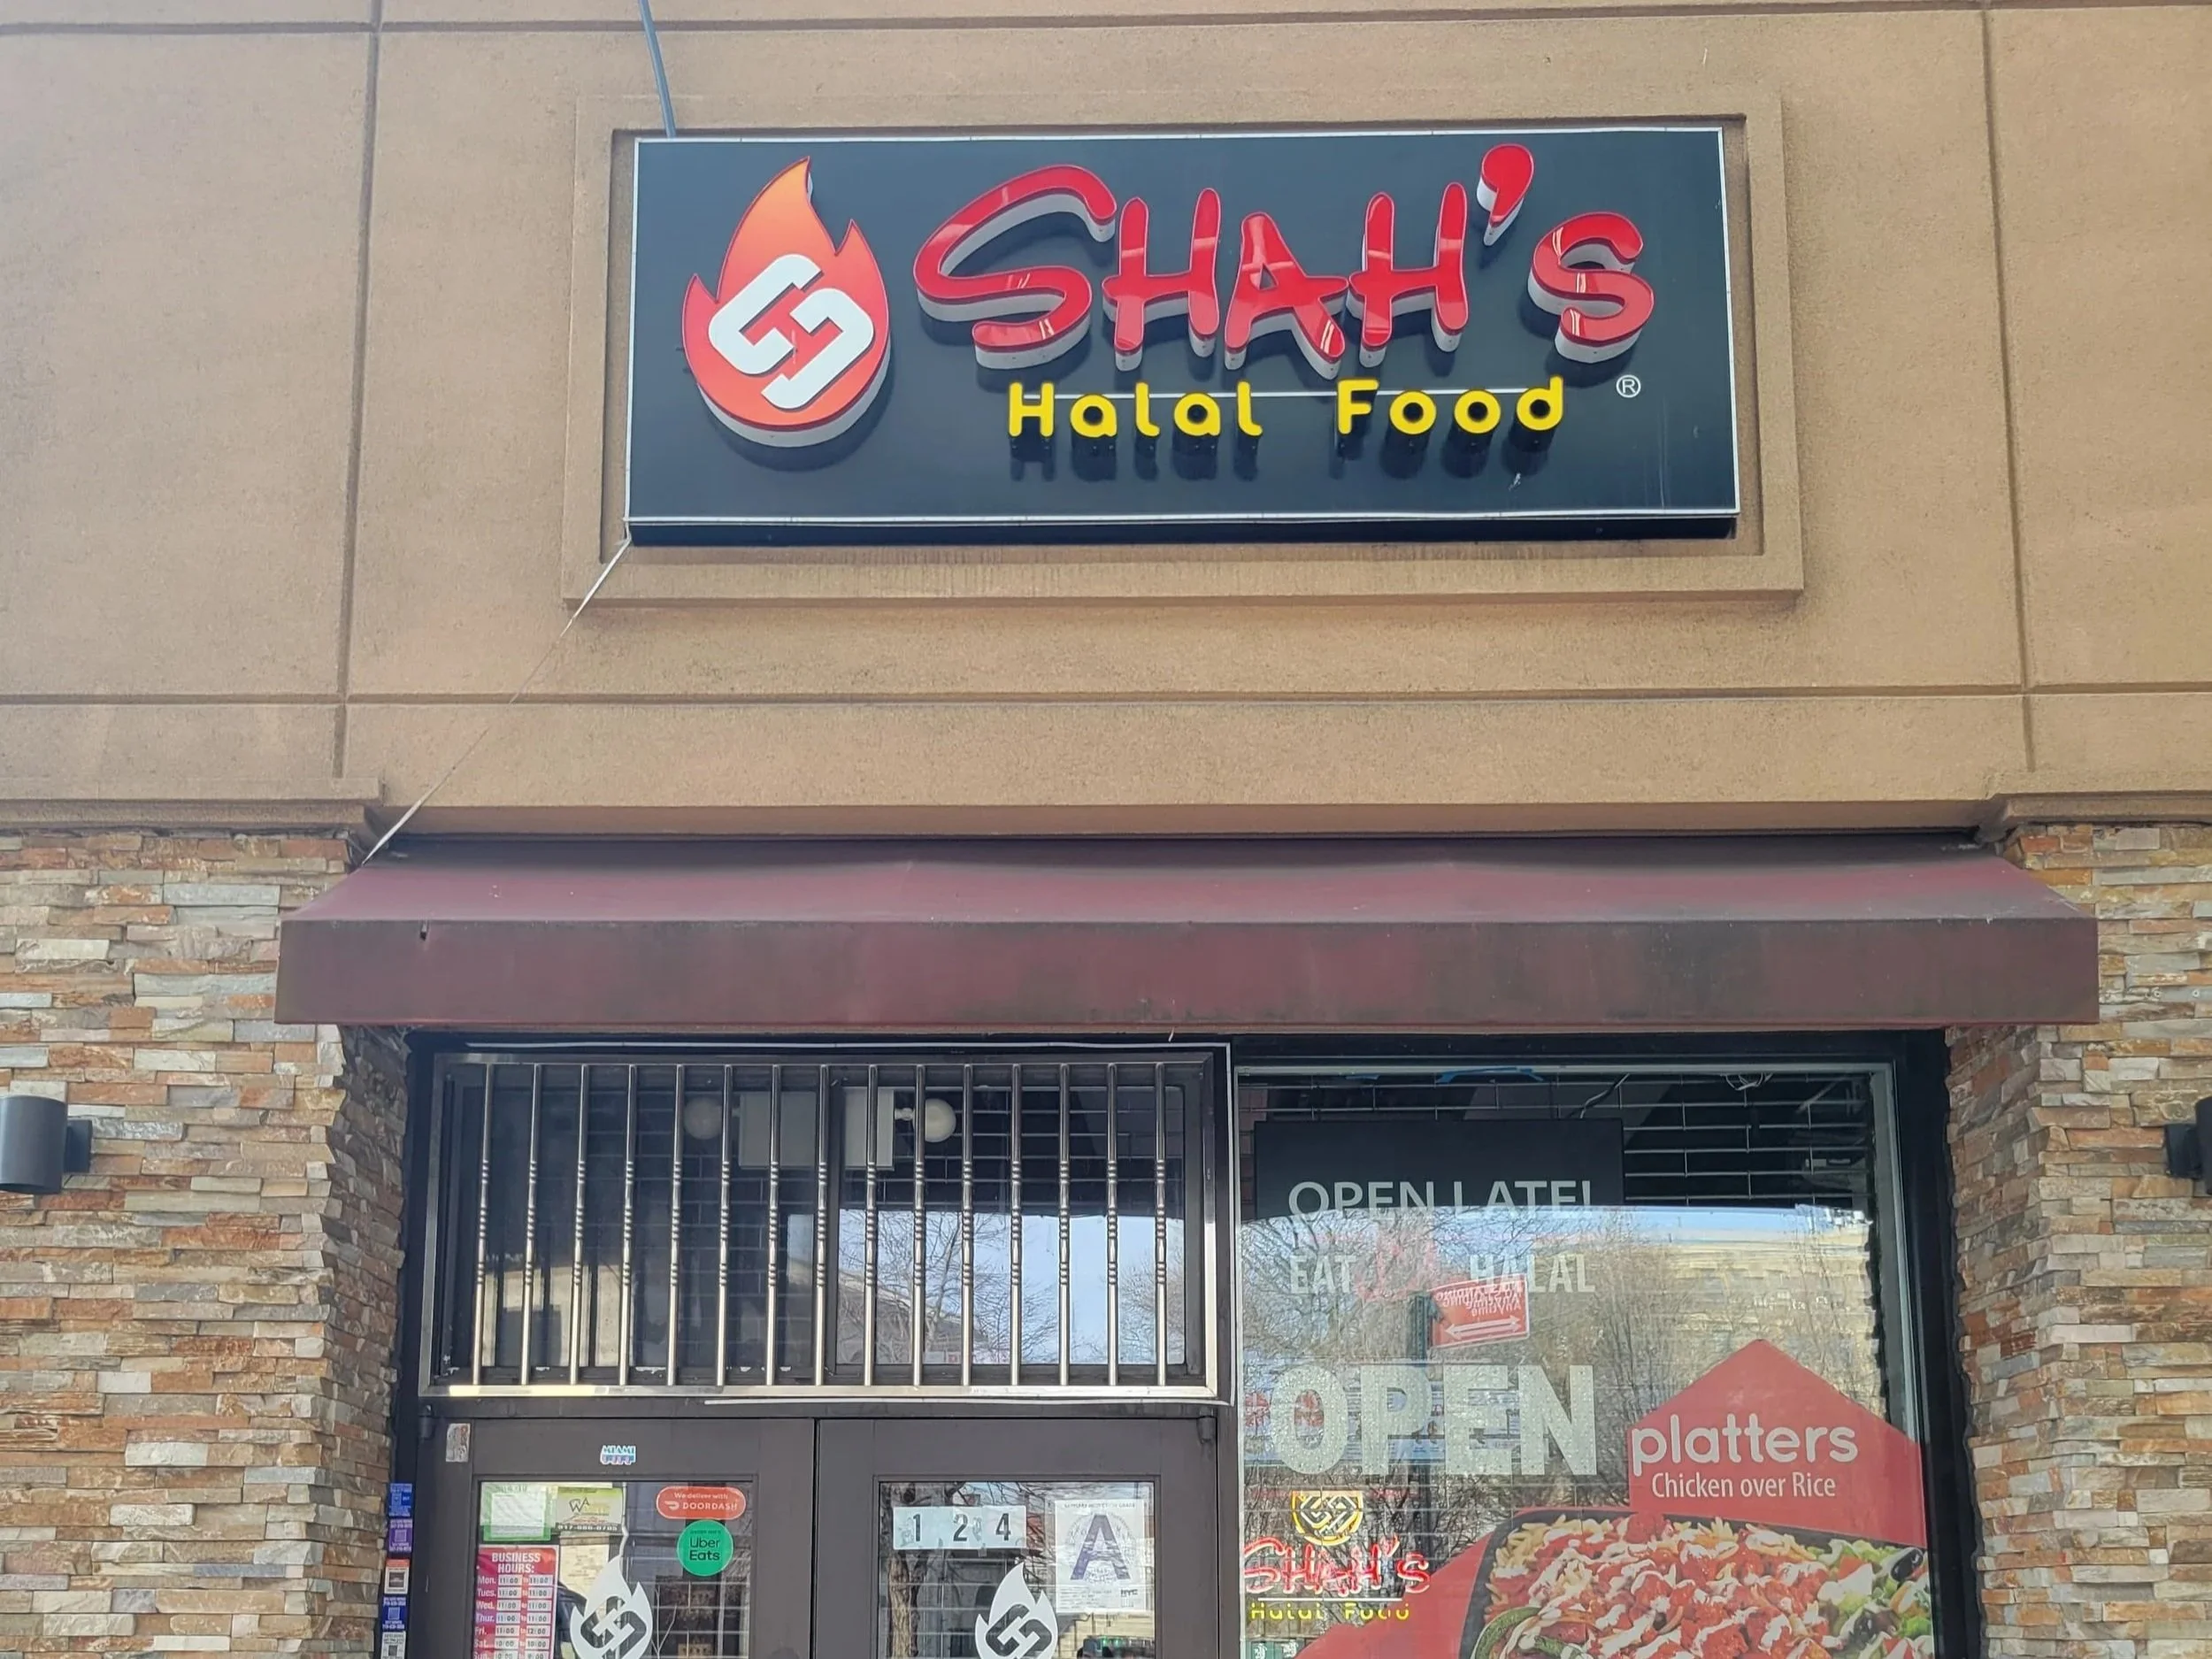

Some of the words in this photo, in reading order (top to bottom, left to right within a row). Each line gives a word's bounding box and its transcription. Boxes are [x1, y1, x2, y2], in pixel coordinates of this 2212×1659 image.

[1007, 381, 1263, 439] Halal
[1334, 378, 1566, 437] Food
[1288, 1180, 1435, 1220] OPEN
[1453, 1179, 1592, 1220] LATE!
[1289, 1255, 1356, 1294] EAT
[1469, 1253, 1596, 1294] HALAL
[1270, 1364, 1598, 1476] OPEN
[1631, 1413, 1859, 1478] platters
[1651, 1471, 1734, 1499] Chicken
[1740, 1477, 1786, 1498] over
[1792, 1471, 1837, 1498] Rice
[682, 1502, 737, 1511] DOORDASH
[690, 1536, 721, 1548] Uber
[1070, 1514, 1131, 1580] A
[491, 1552, 542, 1563] BUSINESS
[690, 1549, 721, 1562] Eats
[497, 1563, 535, 1574] HOURS:
[478, 1576, 496, 1585] Mon.
[478, 1588, 496, 1597] Tues.
[476, 1600, 495, 1609] Wed.
[475, 1613, 495, 1623] Thur.
[474, 1626, 488, 1635] Fri.
